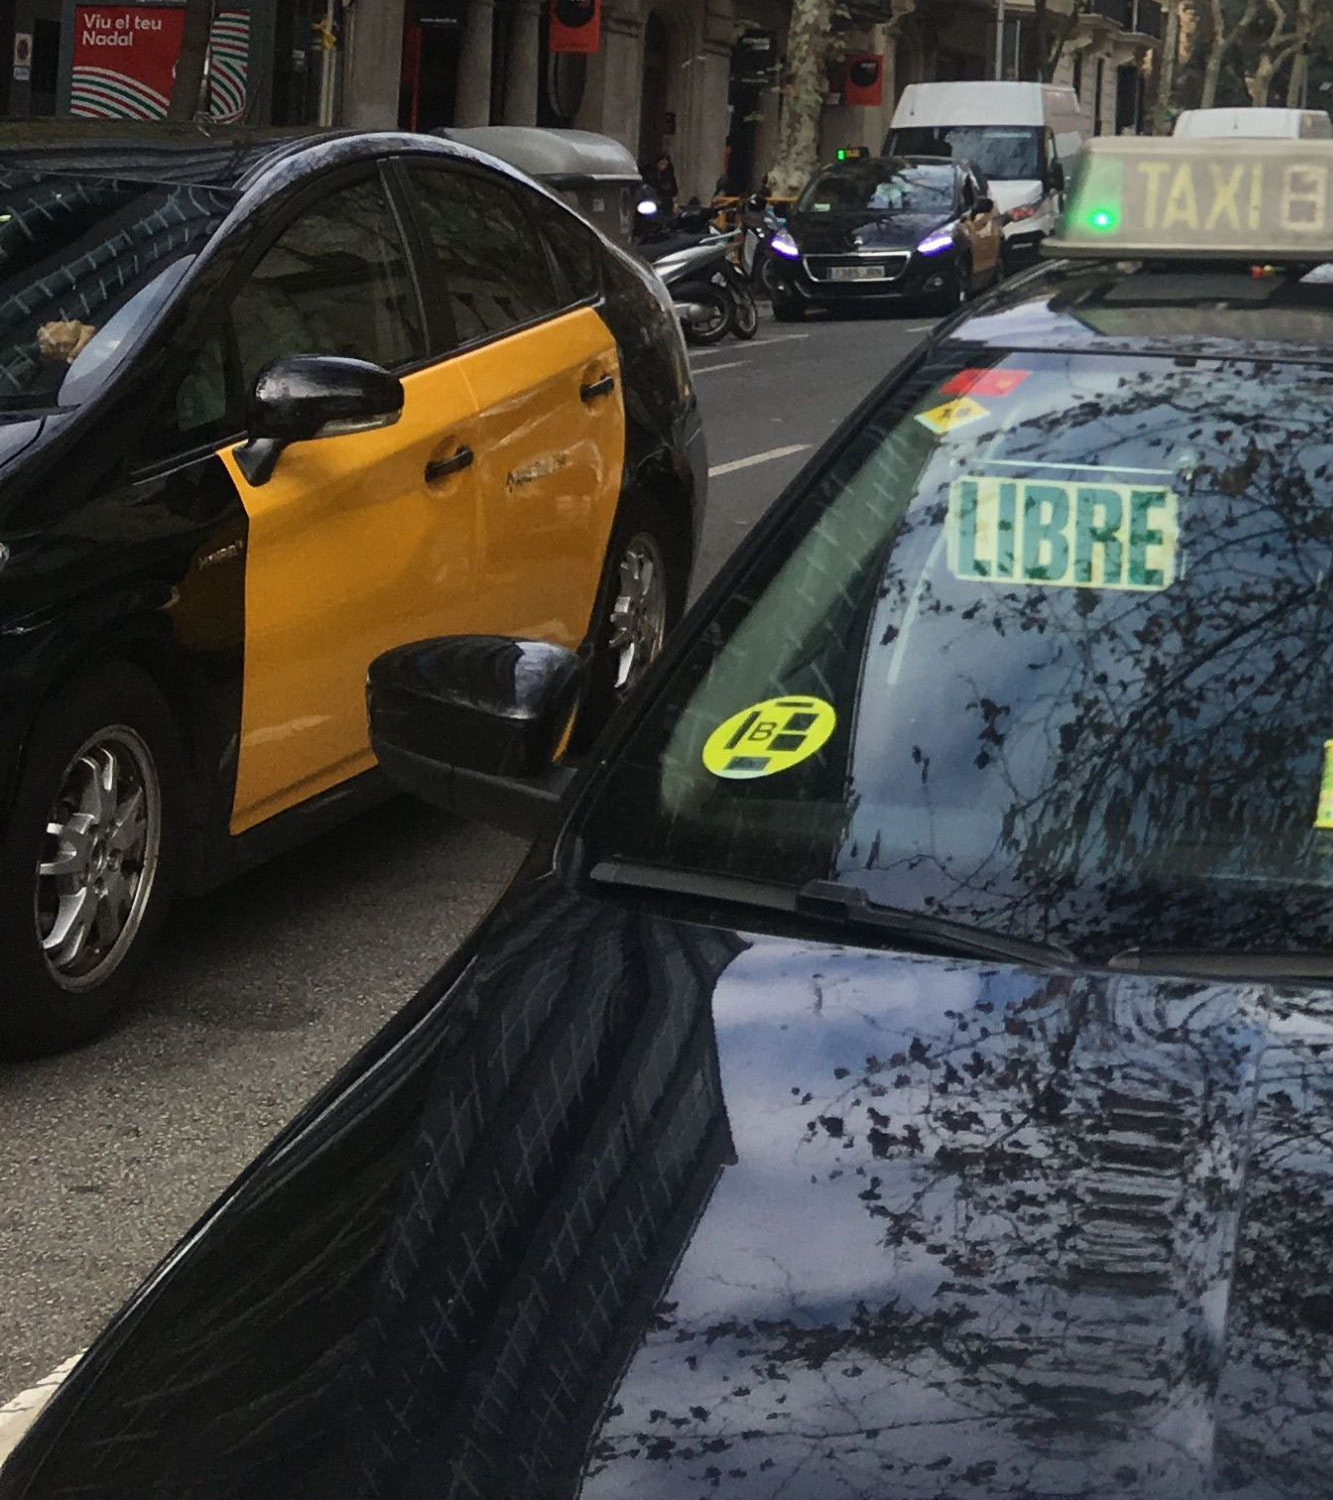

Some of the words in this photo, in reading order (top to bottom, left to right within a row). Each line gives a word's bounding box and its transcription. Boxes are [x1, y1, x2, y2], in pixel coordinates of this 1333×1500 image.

[83, 13, 111, 29] Viu
[115, 14, 130, 29] el
[134, 16, 162, 31] teu
[82, 30, 134, 47] Nadal
[1137, 161, 1264, 231] TAXI
[957, 481, 1167, 587] LIBRE
[747, 721, 778, 741] B
